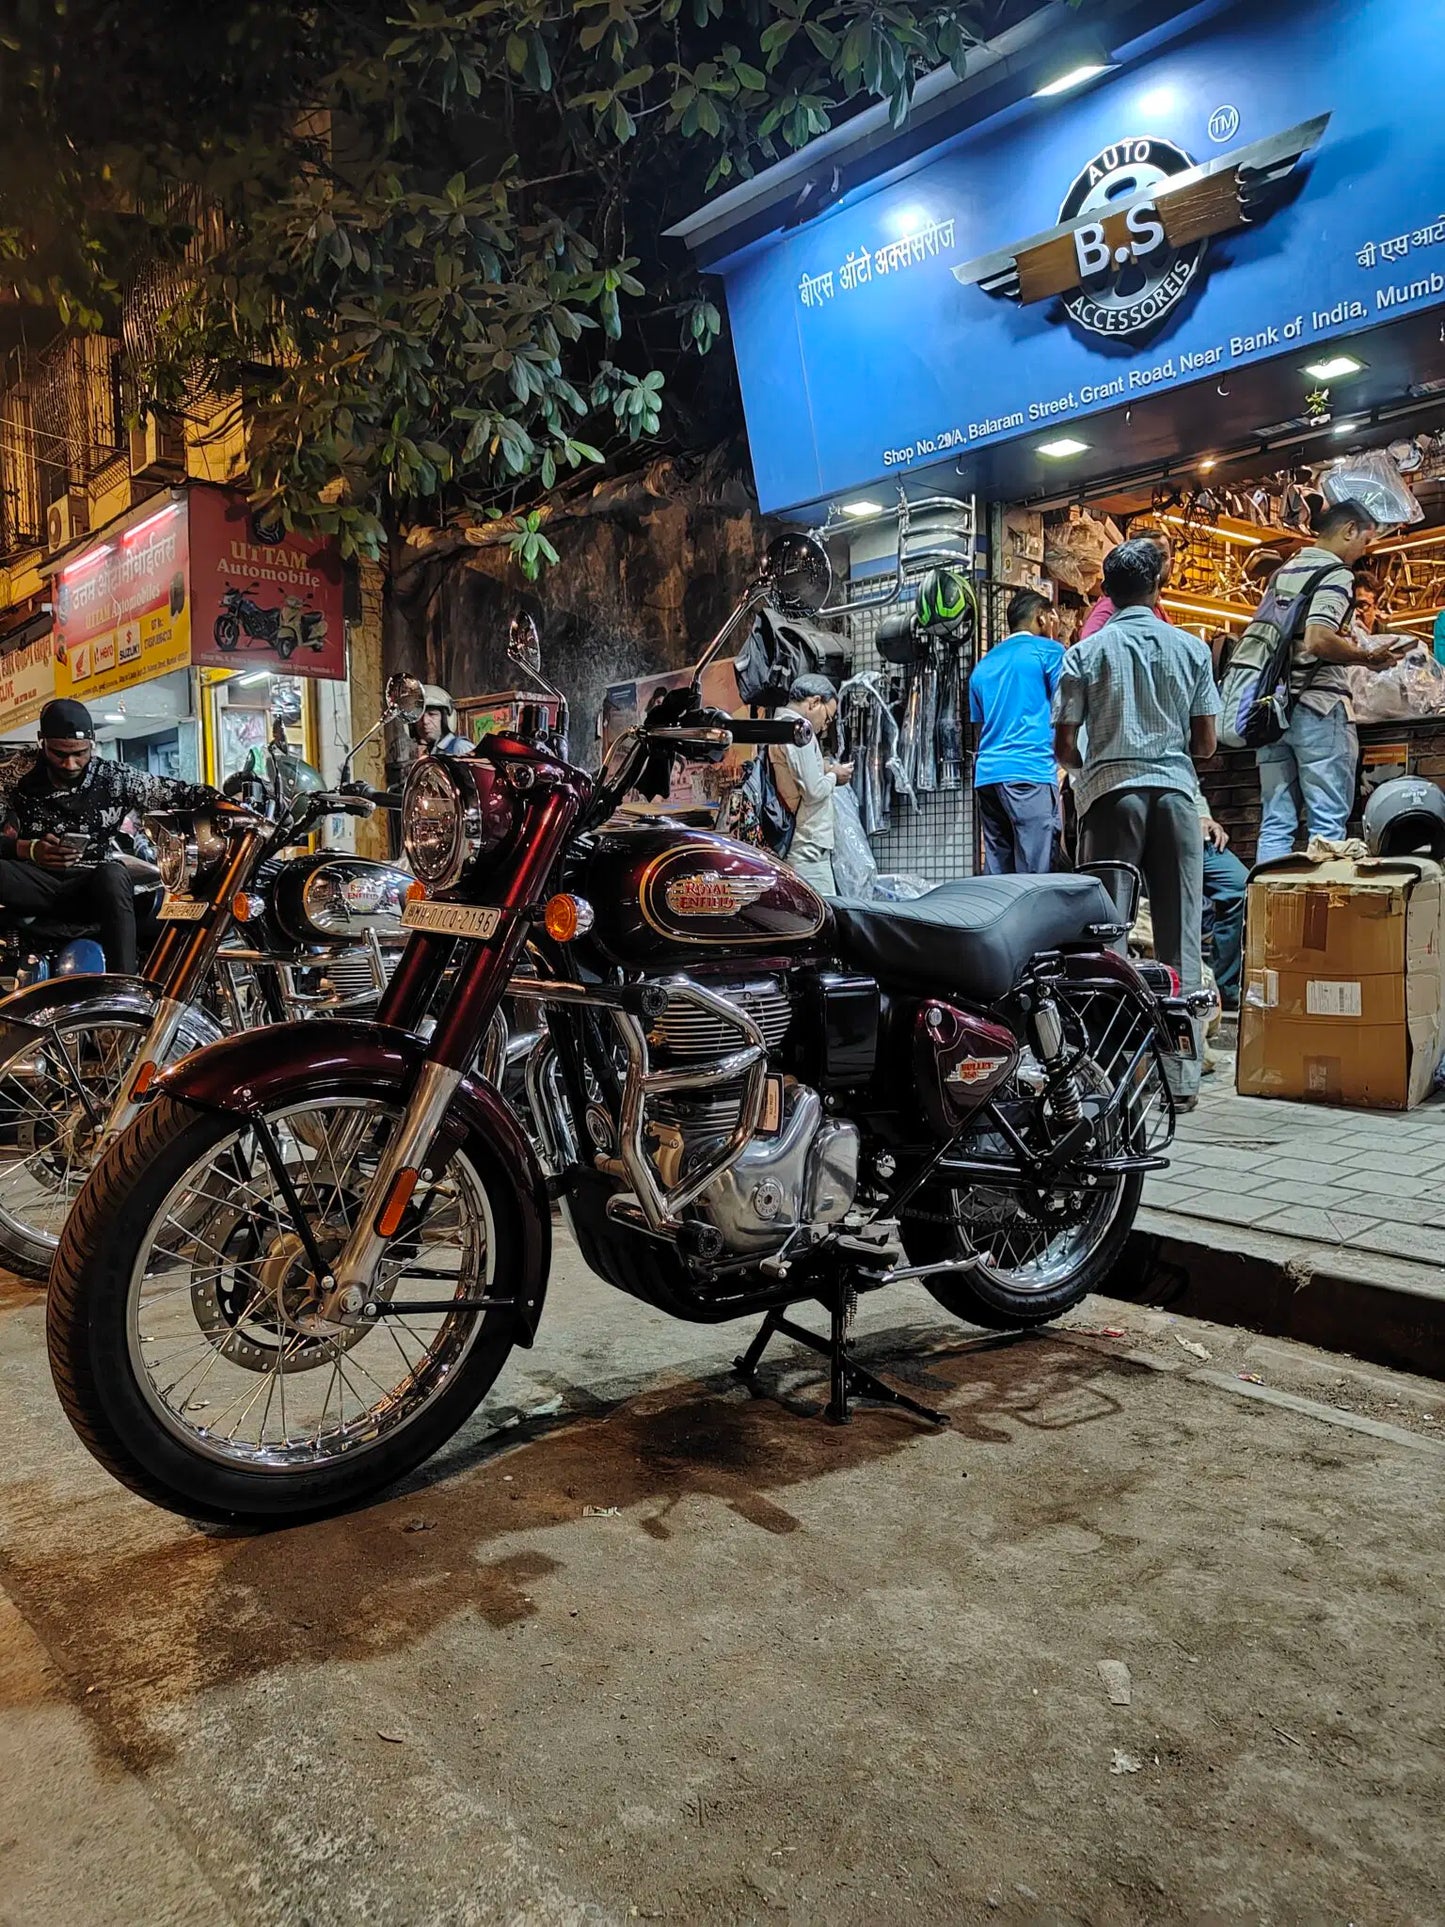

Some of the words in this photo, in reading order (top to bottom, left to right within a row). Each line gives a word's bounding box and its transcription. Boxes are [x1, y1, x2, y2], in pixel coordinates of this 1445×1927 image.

[1088, 140, 1150, 185] AUTO
[1073, 200, 1165, 278] B.S
[1355, 242, 1377, 267] बी
[1379, 234, 1411, 262] एस
[799, 272, 834, 307] बीएस
[839, 245, 873, 290] ऑटो
[1070, 259, 1190, 331] ACCESSOREIS
[883, 446, 914, 465] Shop
[968, 411, 1024, 440] Balaram
[1028, 392, 1079, 421] Street,
[1080, 376, 1125, 404] Grant
[1129, 360, 1177, 389] Road,
[1179, 346, 1223, 373] Near
[1230, 327, 1279, 357] Bank
[1283, 316, 1303, 339] of
[1312, 301, 1368, 331] India,
[216, 558, 321, 587] Automobile
[229, 540, 309, 570] UTTAM
[119, 643, 140, 661] SUZUKI
[684, 881, 730, 896] ROYAL
